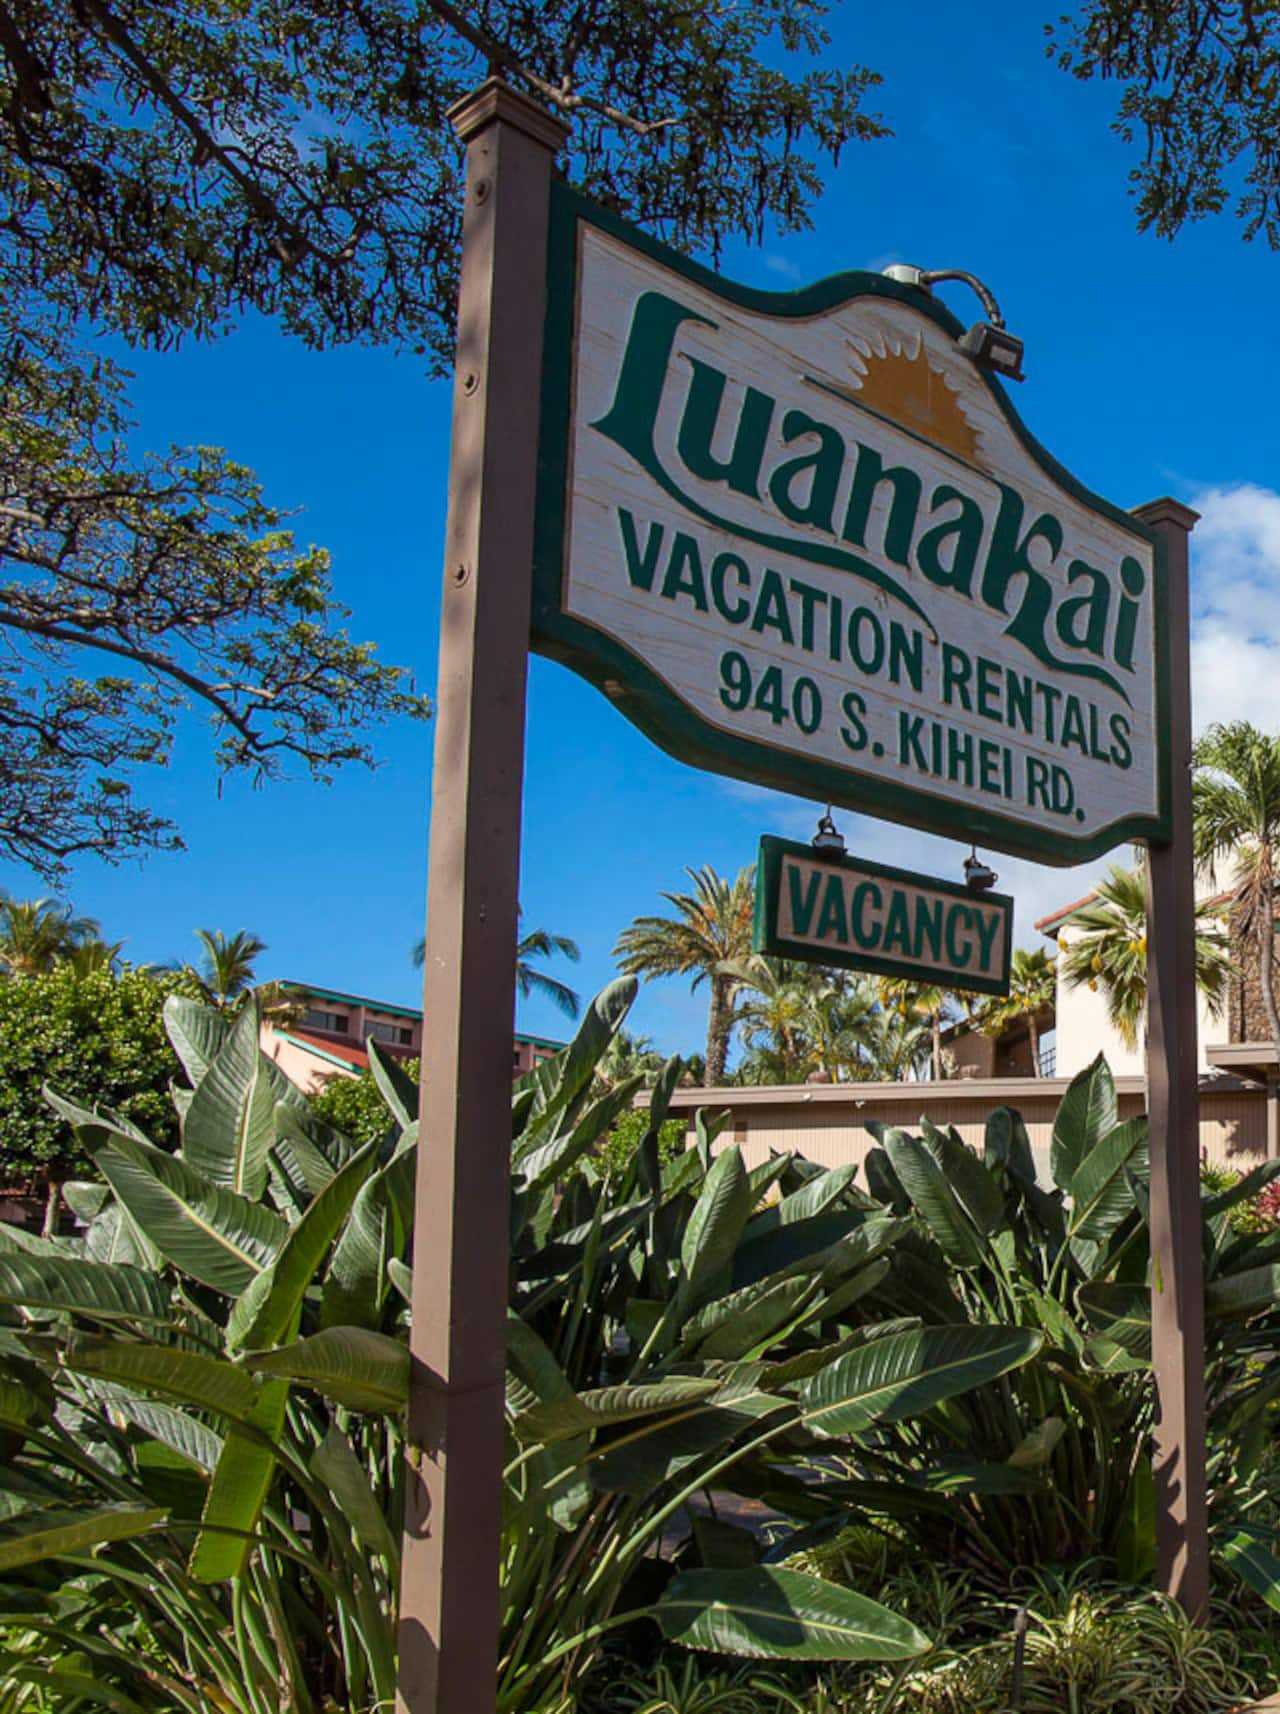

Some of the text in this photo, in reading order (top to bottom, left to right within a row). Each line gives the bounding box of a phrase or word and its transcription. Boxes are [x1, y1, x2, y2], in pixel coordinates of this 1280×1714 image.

[617, 506, 1132, 769] VACATION RENTALS
[719, 651, 1085, 823] 940 S. KIHEI RD.
[788, 864, 1000, 972] VACANCY
